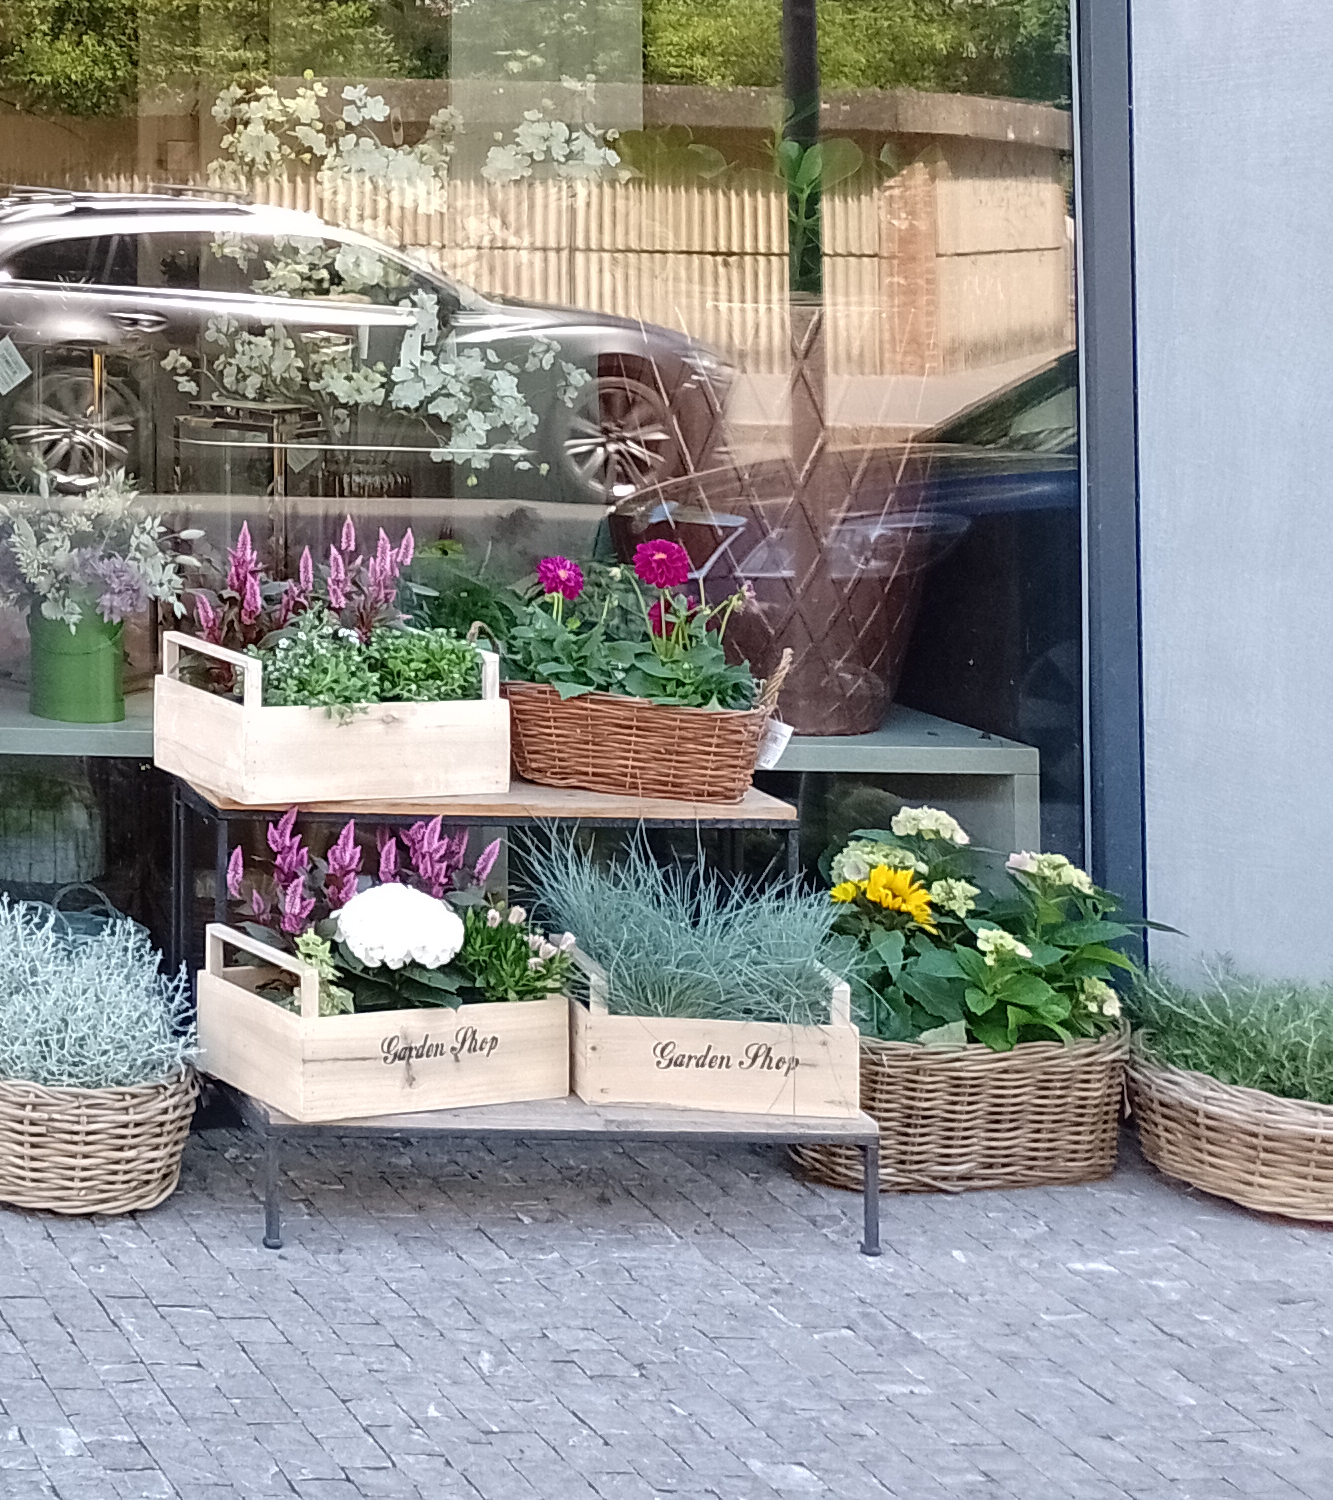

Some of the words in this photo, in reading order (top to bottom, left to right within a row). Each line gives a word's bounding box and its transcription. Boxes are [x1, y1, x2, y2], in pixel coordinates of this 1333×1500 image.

[381, 1033, 446, 1065] Garden
[450, 1025, 499, 1057] Shop
[652, 1041, 732, 1069] Garden
[738, 1042, 800, 1077] Shop
